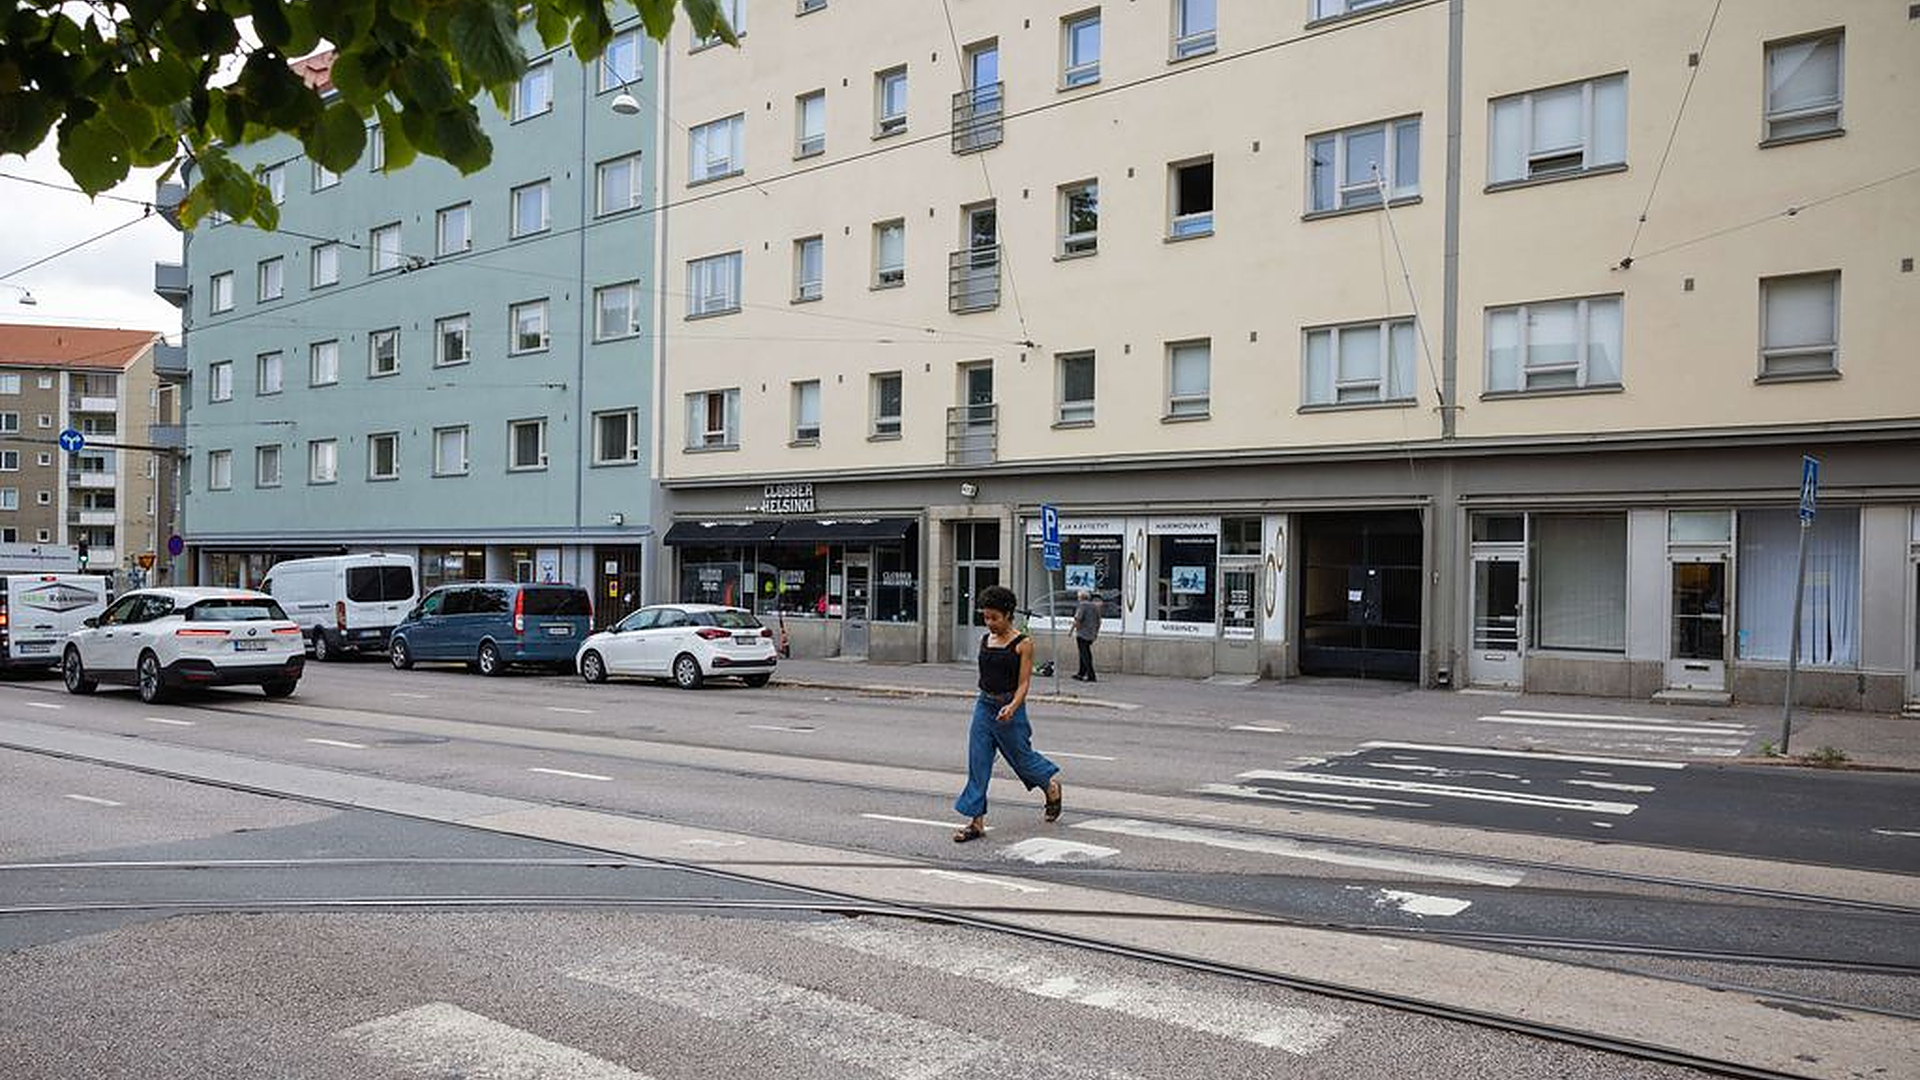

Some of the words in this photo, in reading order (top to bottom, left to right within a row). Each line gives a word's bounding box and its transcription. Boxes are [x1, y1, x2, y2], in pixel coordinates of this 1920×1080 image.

[764, 483, 813, 498] CLOBBER
[762, 498, 815, 513] HELSINKI
[1045, 508, 1057, 541] P
